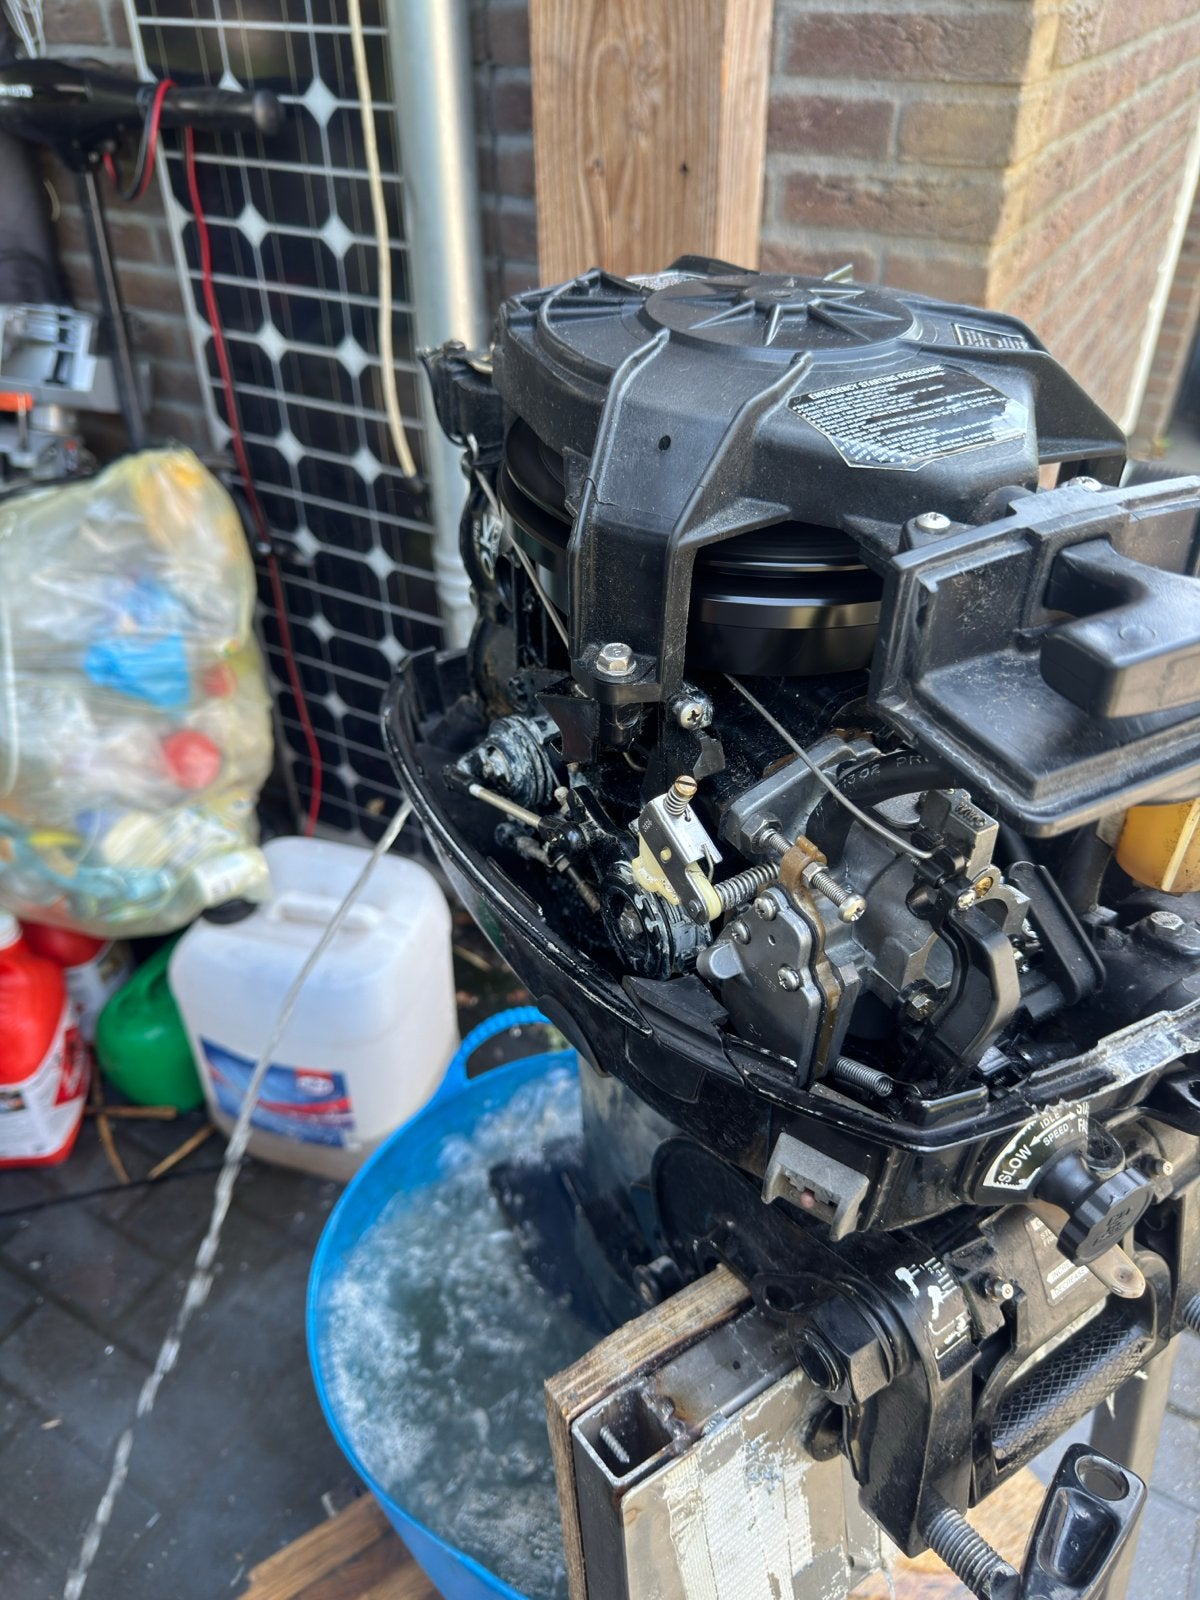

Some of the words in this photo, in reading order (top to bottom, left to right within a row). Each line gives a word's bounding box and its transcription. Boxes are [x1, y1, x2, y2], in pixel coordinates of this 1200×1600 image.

[808, 383, 858, 400] EMERGENCY
[858, 375, 898, 387] STARTING
[1039, 1112, 1060, 1129] IDLE
[1043, 1123, 1069, 1146] SPEED
[998, 1144, 1032, 1183] SLOW
